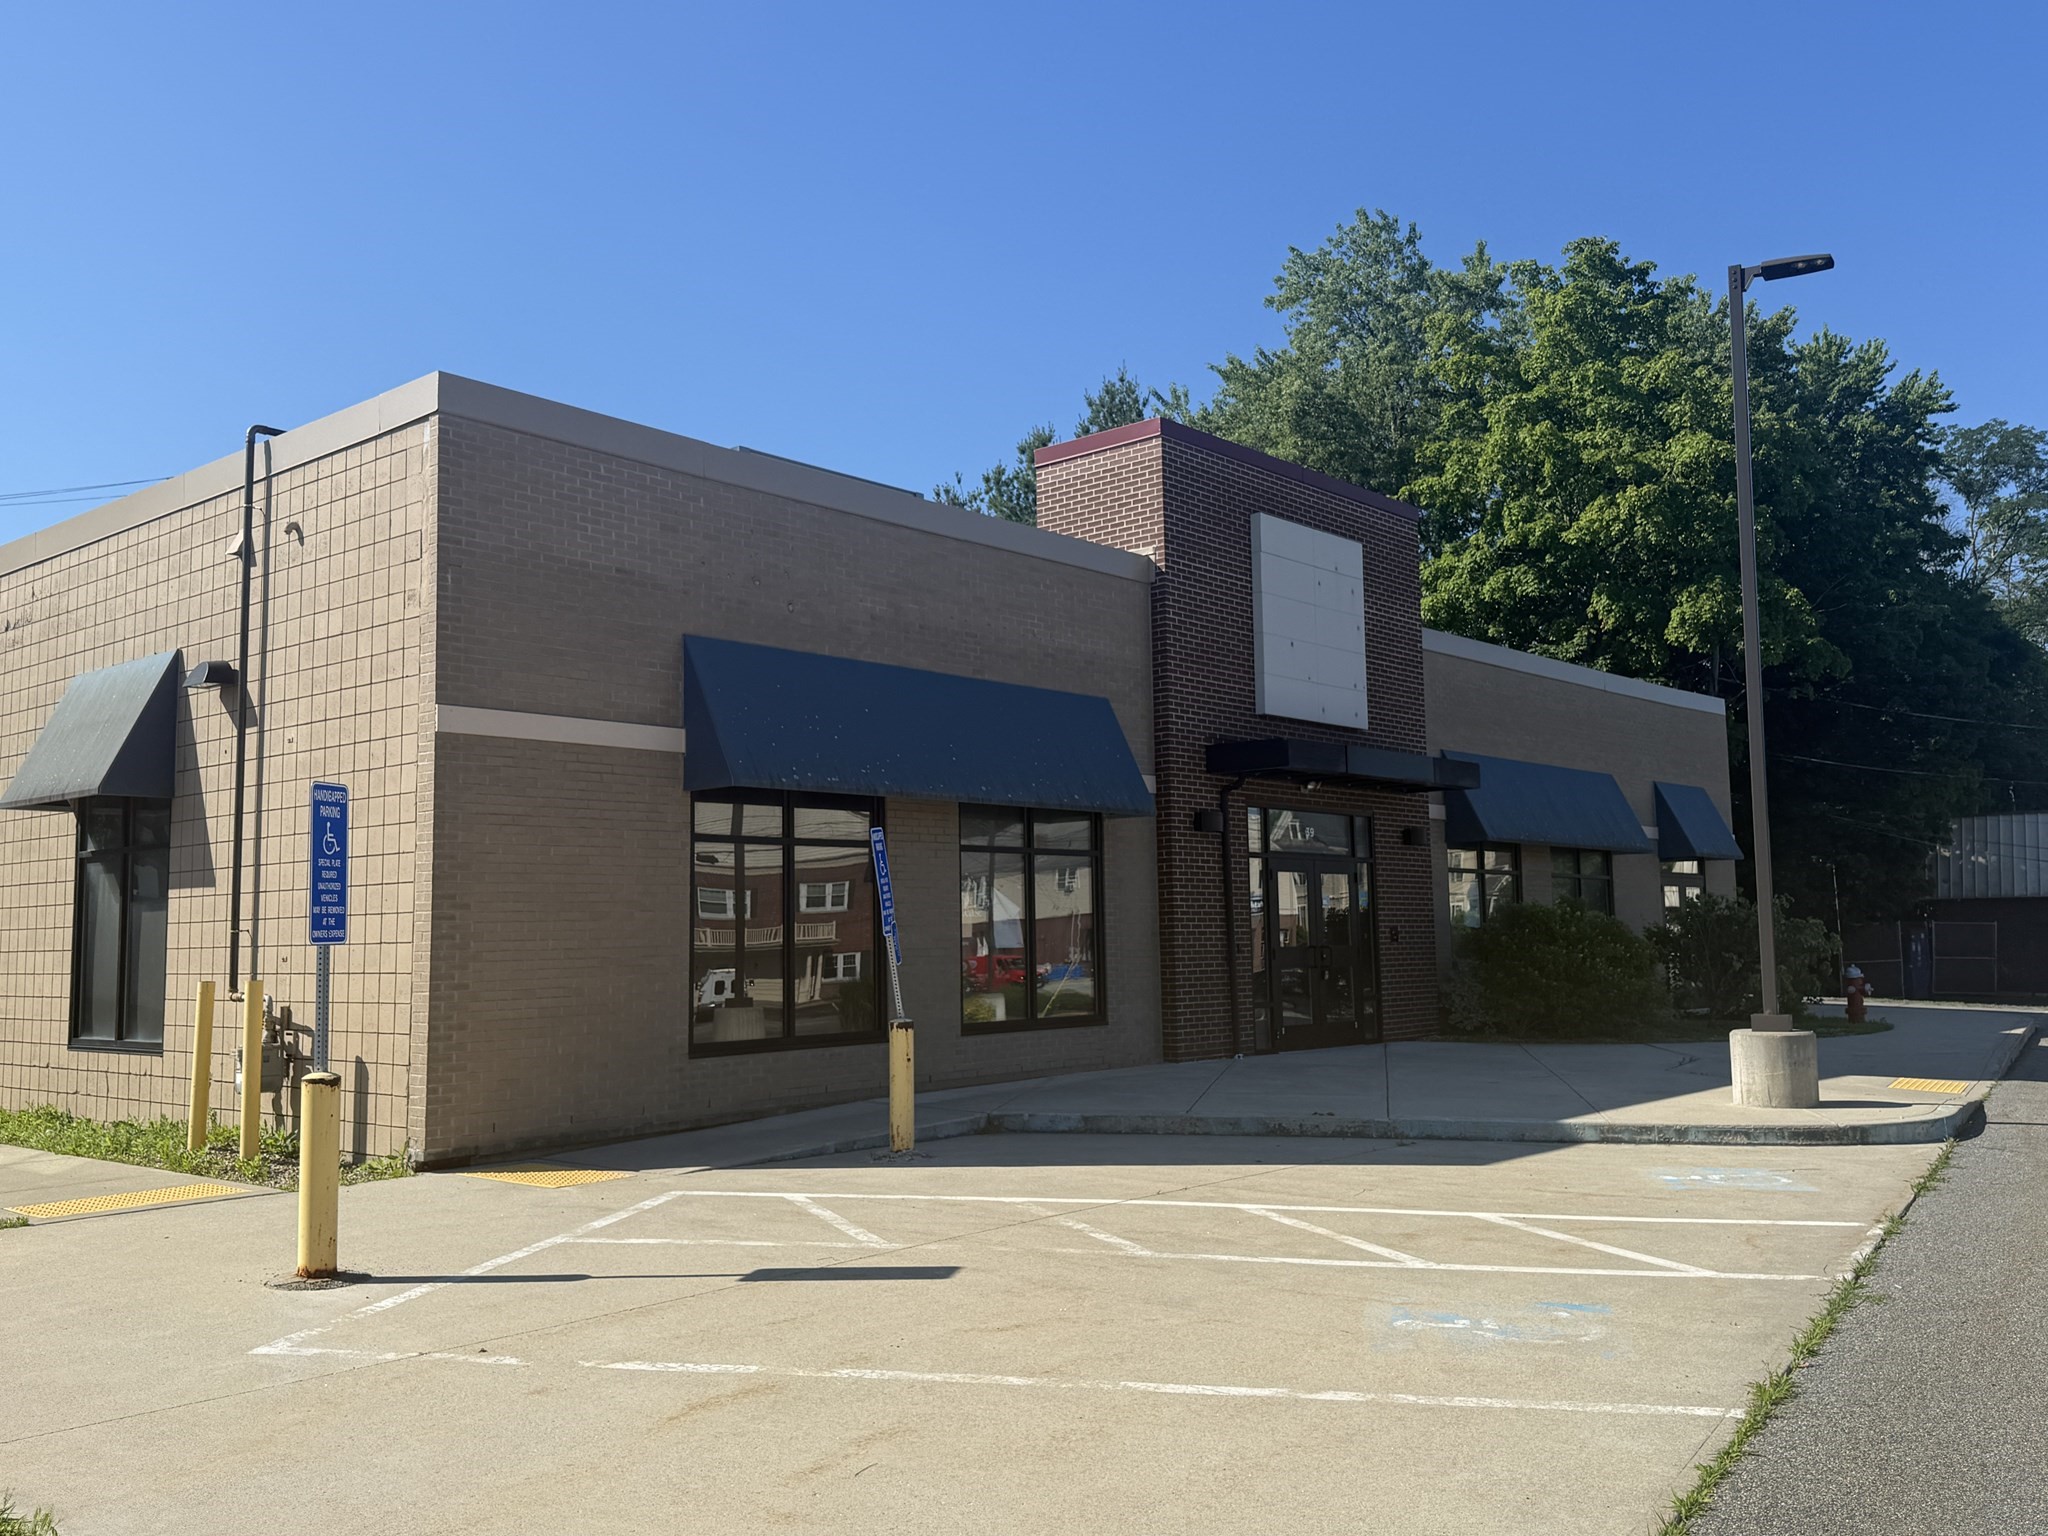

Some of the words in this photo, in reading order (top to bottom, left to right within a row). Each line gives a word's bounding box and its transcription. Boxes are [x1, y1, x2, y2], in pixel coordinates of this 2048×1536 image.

[314, 790, 346, 803] HANDICAPPED
[320, 806, 340, 818] PARKING
[318, 858, 331, 867] SPECIAL
[332, 859, 341, 868] PLATE
[321, 894, 338, 903] VEHICLES
[322, 906, 327, 914] BE
[328, 906, 345, 914] REMOVED
[328, 917, 336, 926] THE
